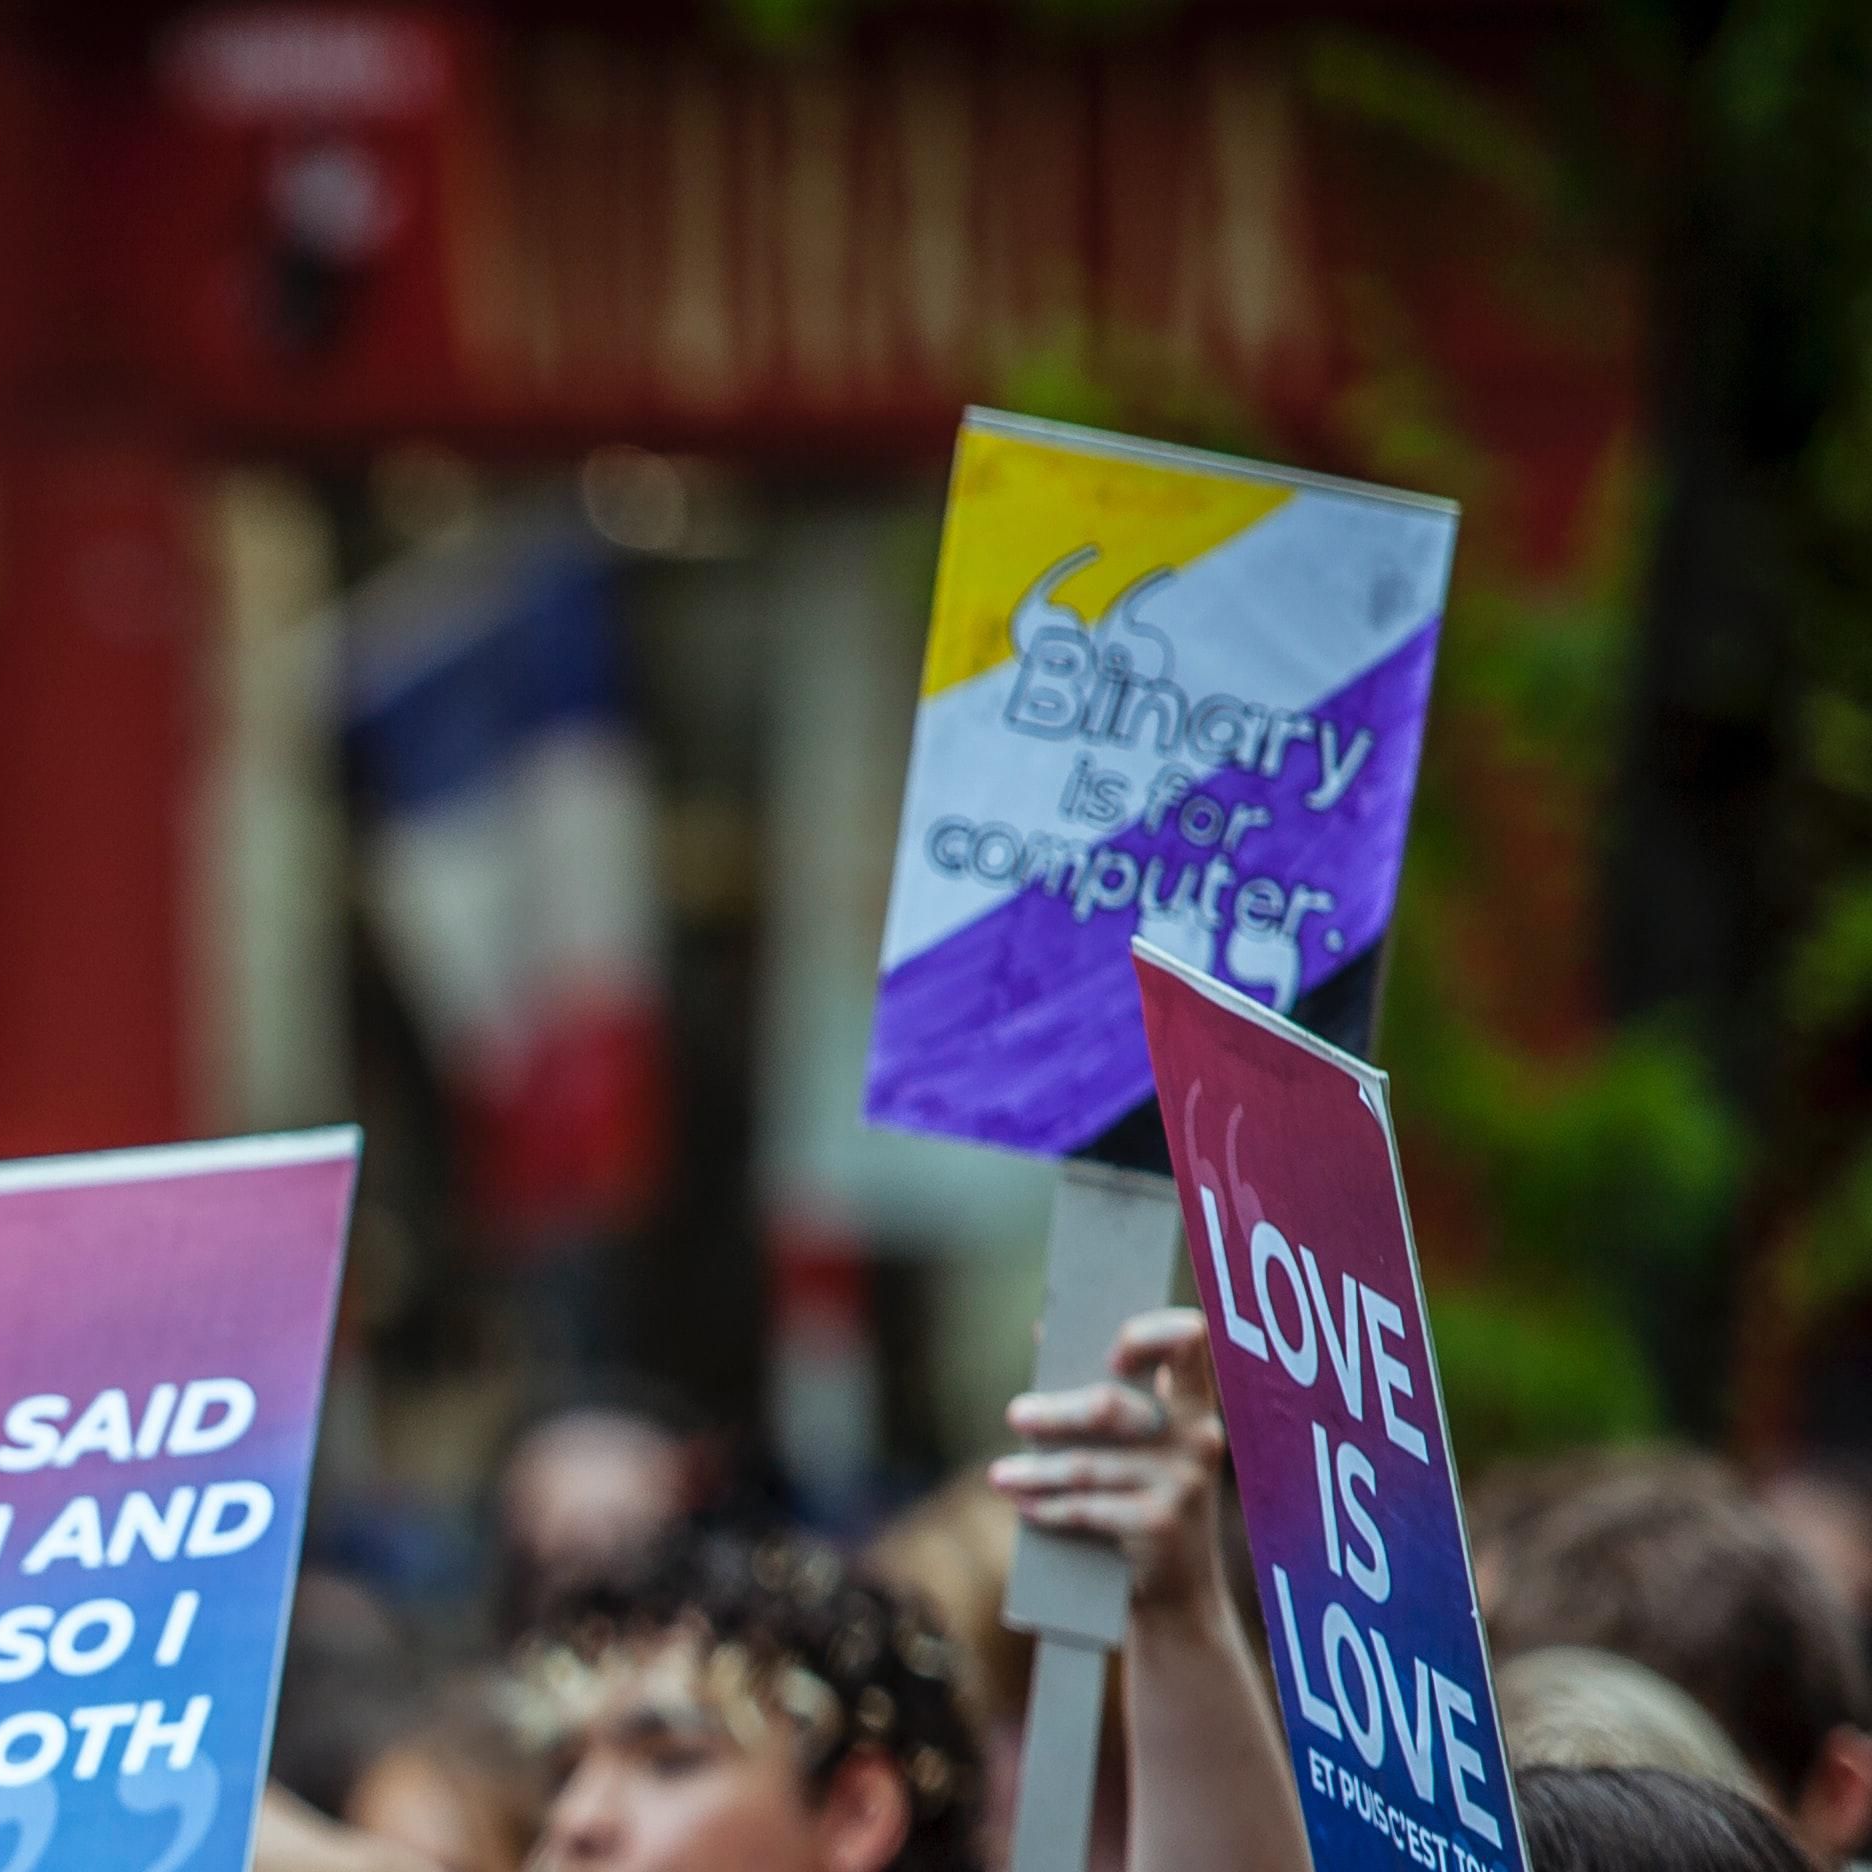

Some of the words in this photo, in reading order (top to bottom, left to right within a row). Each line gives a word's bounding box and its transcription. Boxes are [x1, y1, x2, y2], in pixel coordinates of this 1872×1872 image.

[1001, 624, 1374, 812] Binary
[1060, 750, 1132, 831] is
[1143, 761, 1270, 851] for
[1200, 1183, 1429, 1465] LOVE
[21, 1480, 275, 1575] AND
[1312, 1420, 1391, 1604] IS
[155, 1590, 199, 1667] I
[1272, 1563, 1503, 1850] LOVE
[1309, 1746, 1335, 1800] ET
[1338, 1766, 1389, 1836] PUIS
